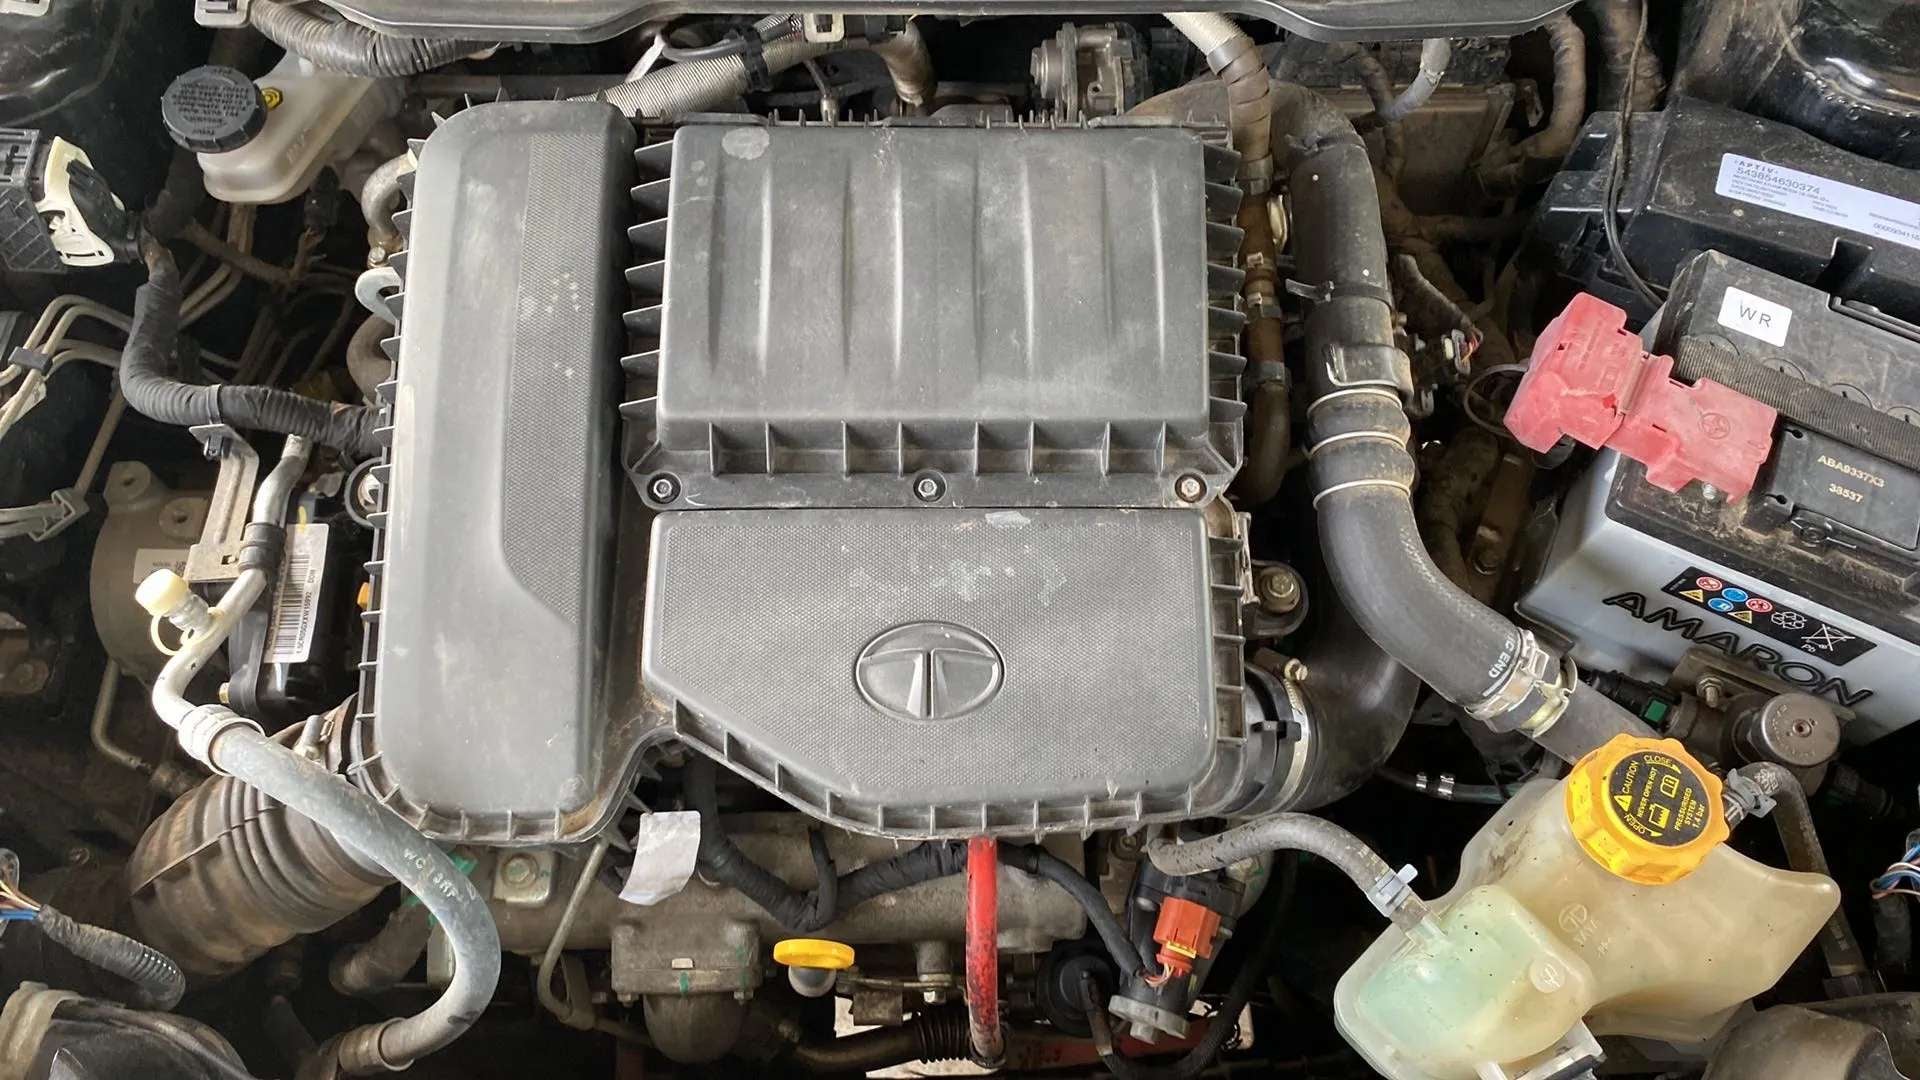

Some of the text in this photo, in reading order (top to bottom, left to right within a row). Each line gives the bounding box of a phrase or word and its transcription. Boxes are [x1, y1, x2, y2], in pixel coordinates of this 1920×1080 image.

[1740, 300, 1771, 327] WR
[1602, 591, 1873, 706] AMARON
[1488, 652, 1511, 678] END
[1643, 755, 1671, 765] CLOSE
[1622, 760, 1639, 793] CAUTION
[1637, 767, 1658, 818] NEVER OPEN HOT
[1624, 813, 1645, 834] OPEN
[1684, 800, 1696, 825] SYSTEM
